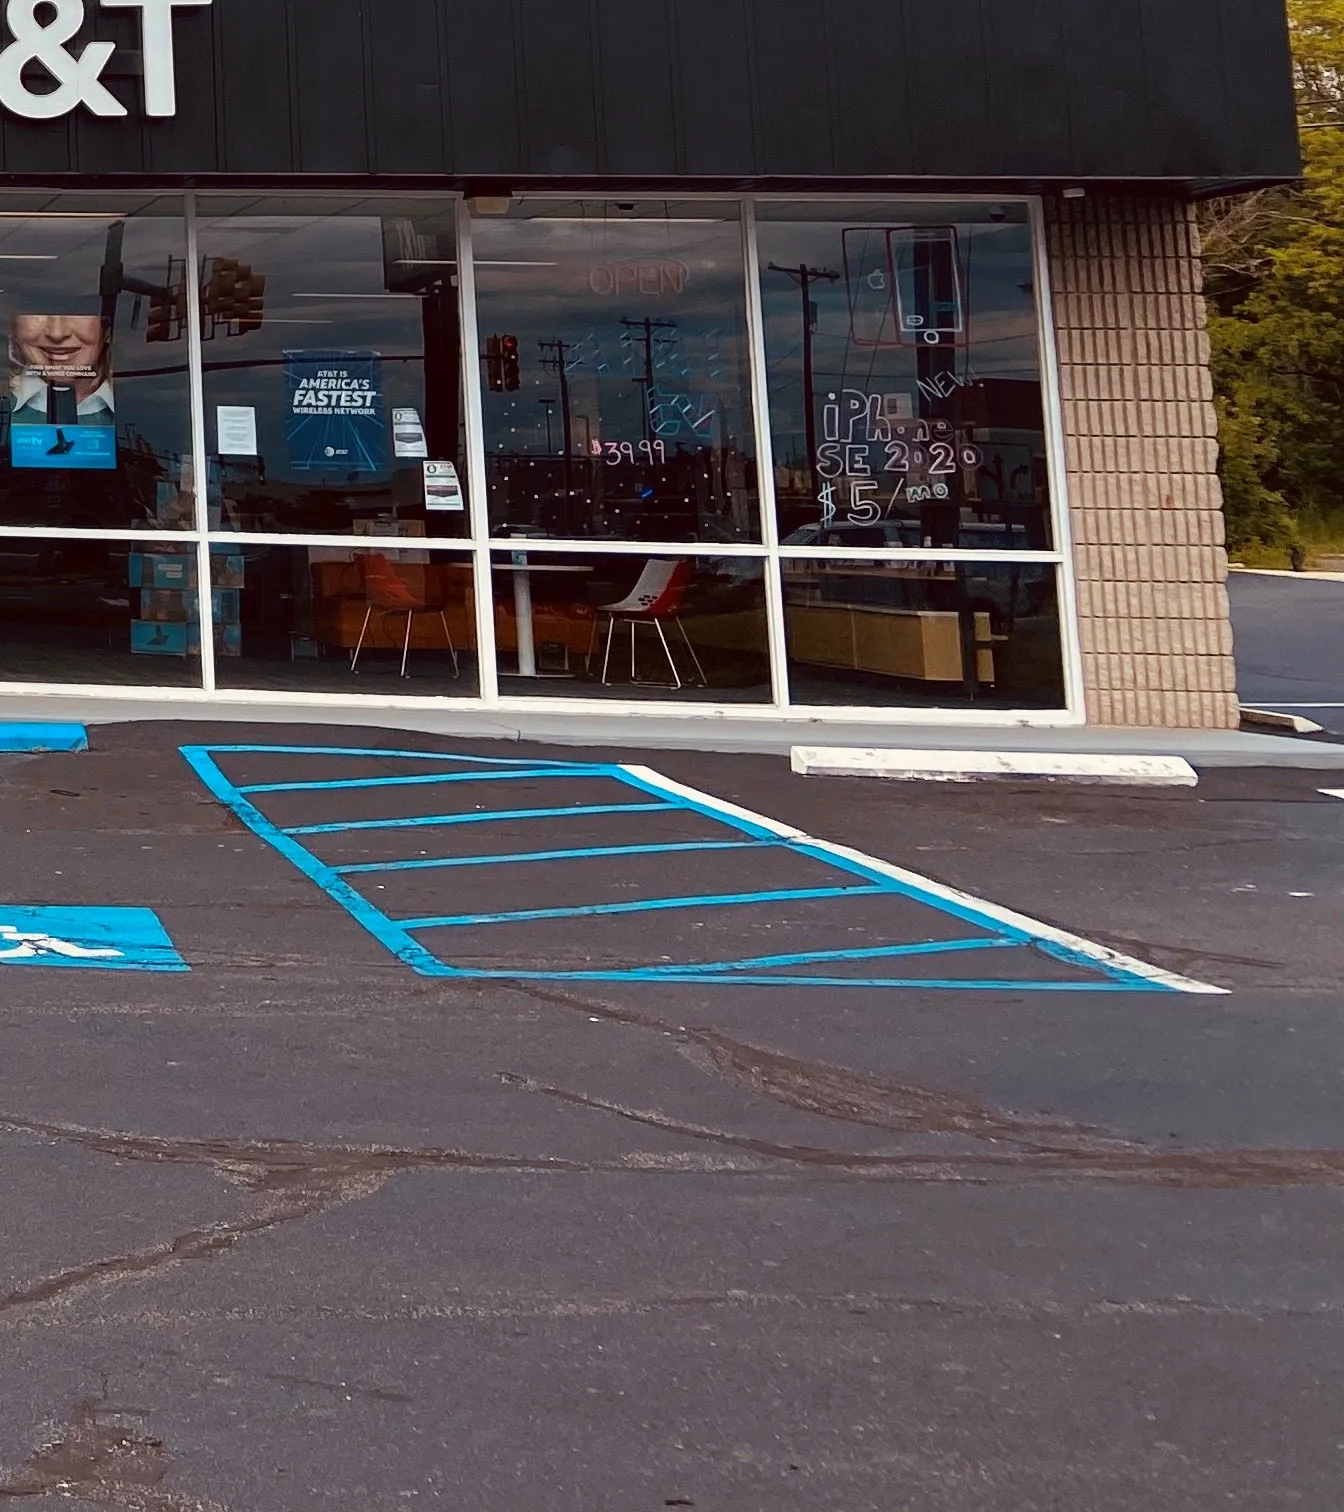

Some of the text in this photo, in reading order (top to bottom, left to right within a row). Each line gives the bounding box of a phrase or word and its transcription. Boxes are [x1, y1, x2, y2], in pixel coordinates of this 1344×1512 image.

[589, 265, 684, 295] OPEN
[316, 370, 348, 378] AT&T IS
[298, 378, 371, 390] AMERICA'S
[292, 389, 377, 407] FASTEST
[292, 406, 376, 416] WIRELESS NETWORK
[823, 389, 954, 443] iPhone
[816, 440, 984, 479] SE 2020
